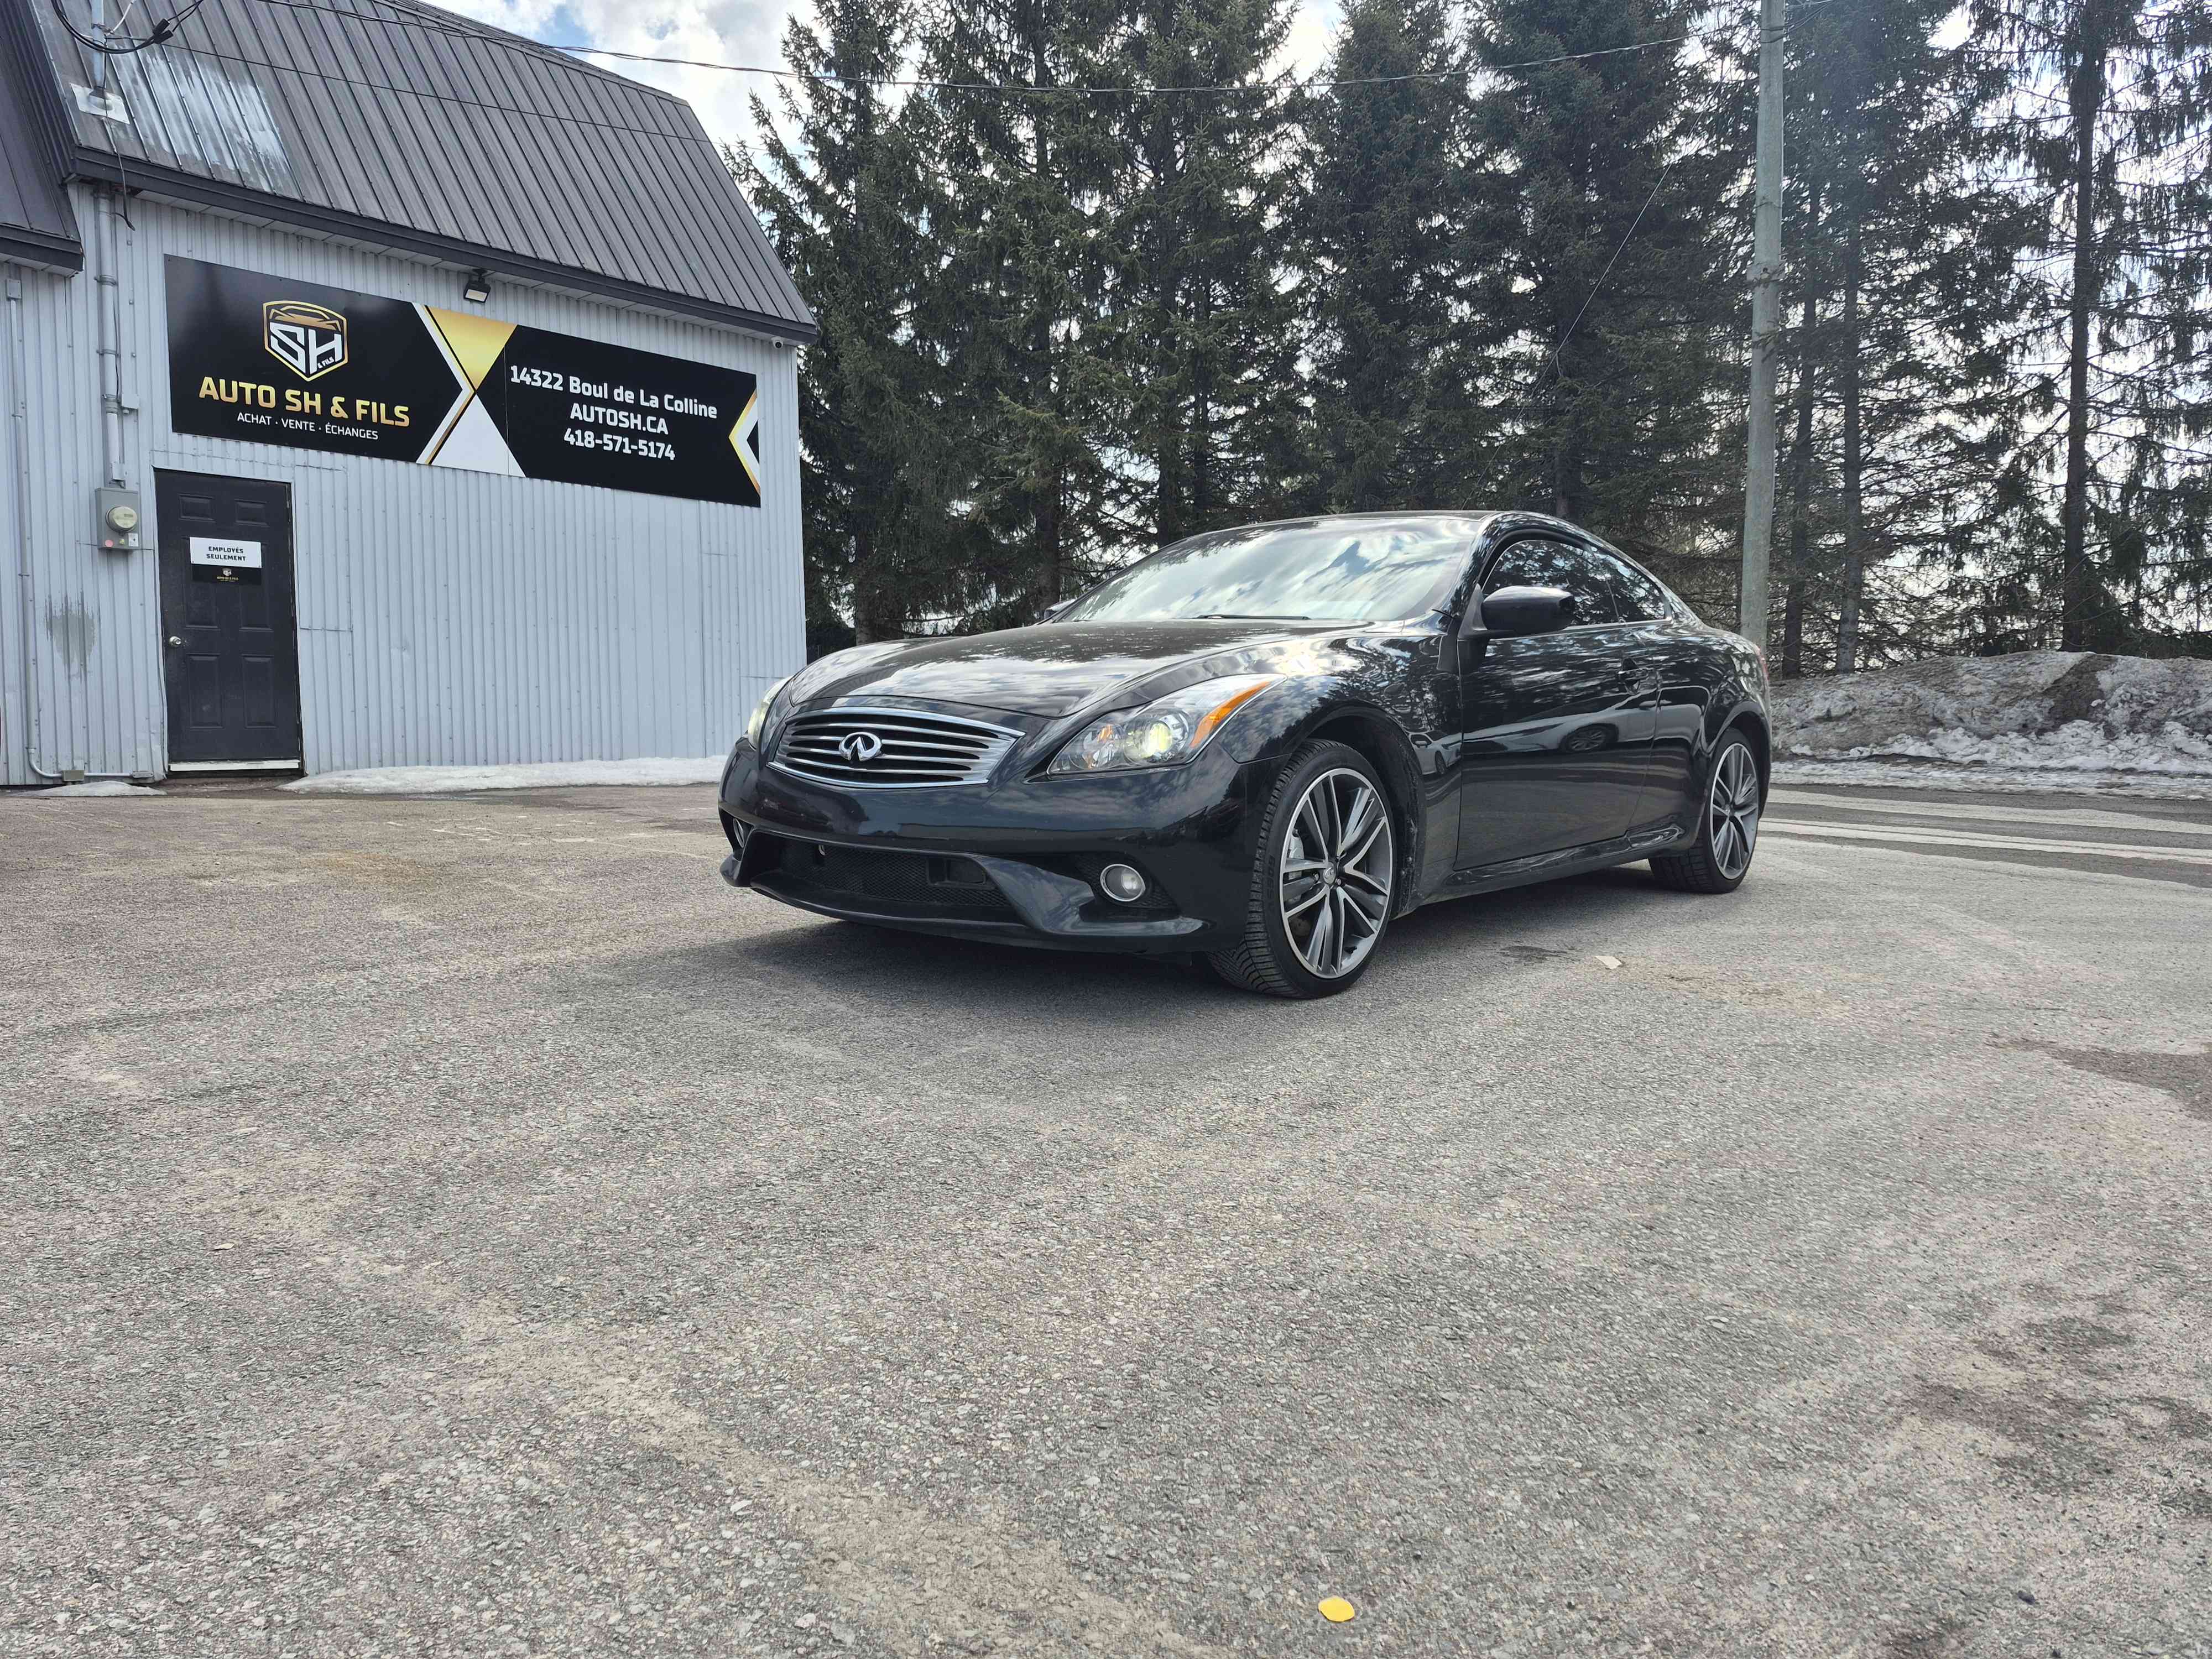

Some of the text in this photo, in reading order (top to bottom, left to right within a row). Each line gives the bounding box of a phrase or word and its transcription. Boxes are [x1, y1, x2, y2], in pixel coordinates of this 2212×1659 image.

[269, 322, 343, 374] SH
[199, 376, 410, 427] AUTO SH & FILS
[510, 365, 717, 419] 14322 Boul de La Colline
[237, 412, 378, 440] ACHAT VENTE ÉCHANGES
[570, 403, 669, 435] AUTOSH.CA
[564, 427, 675, 461] 418-571-5174
